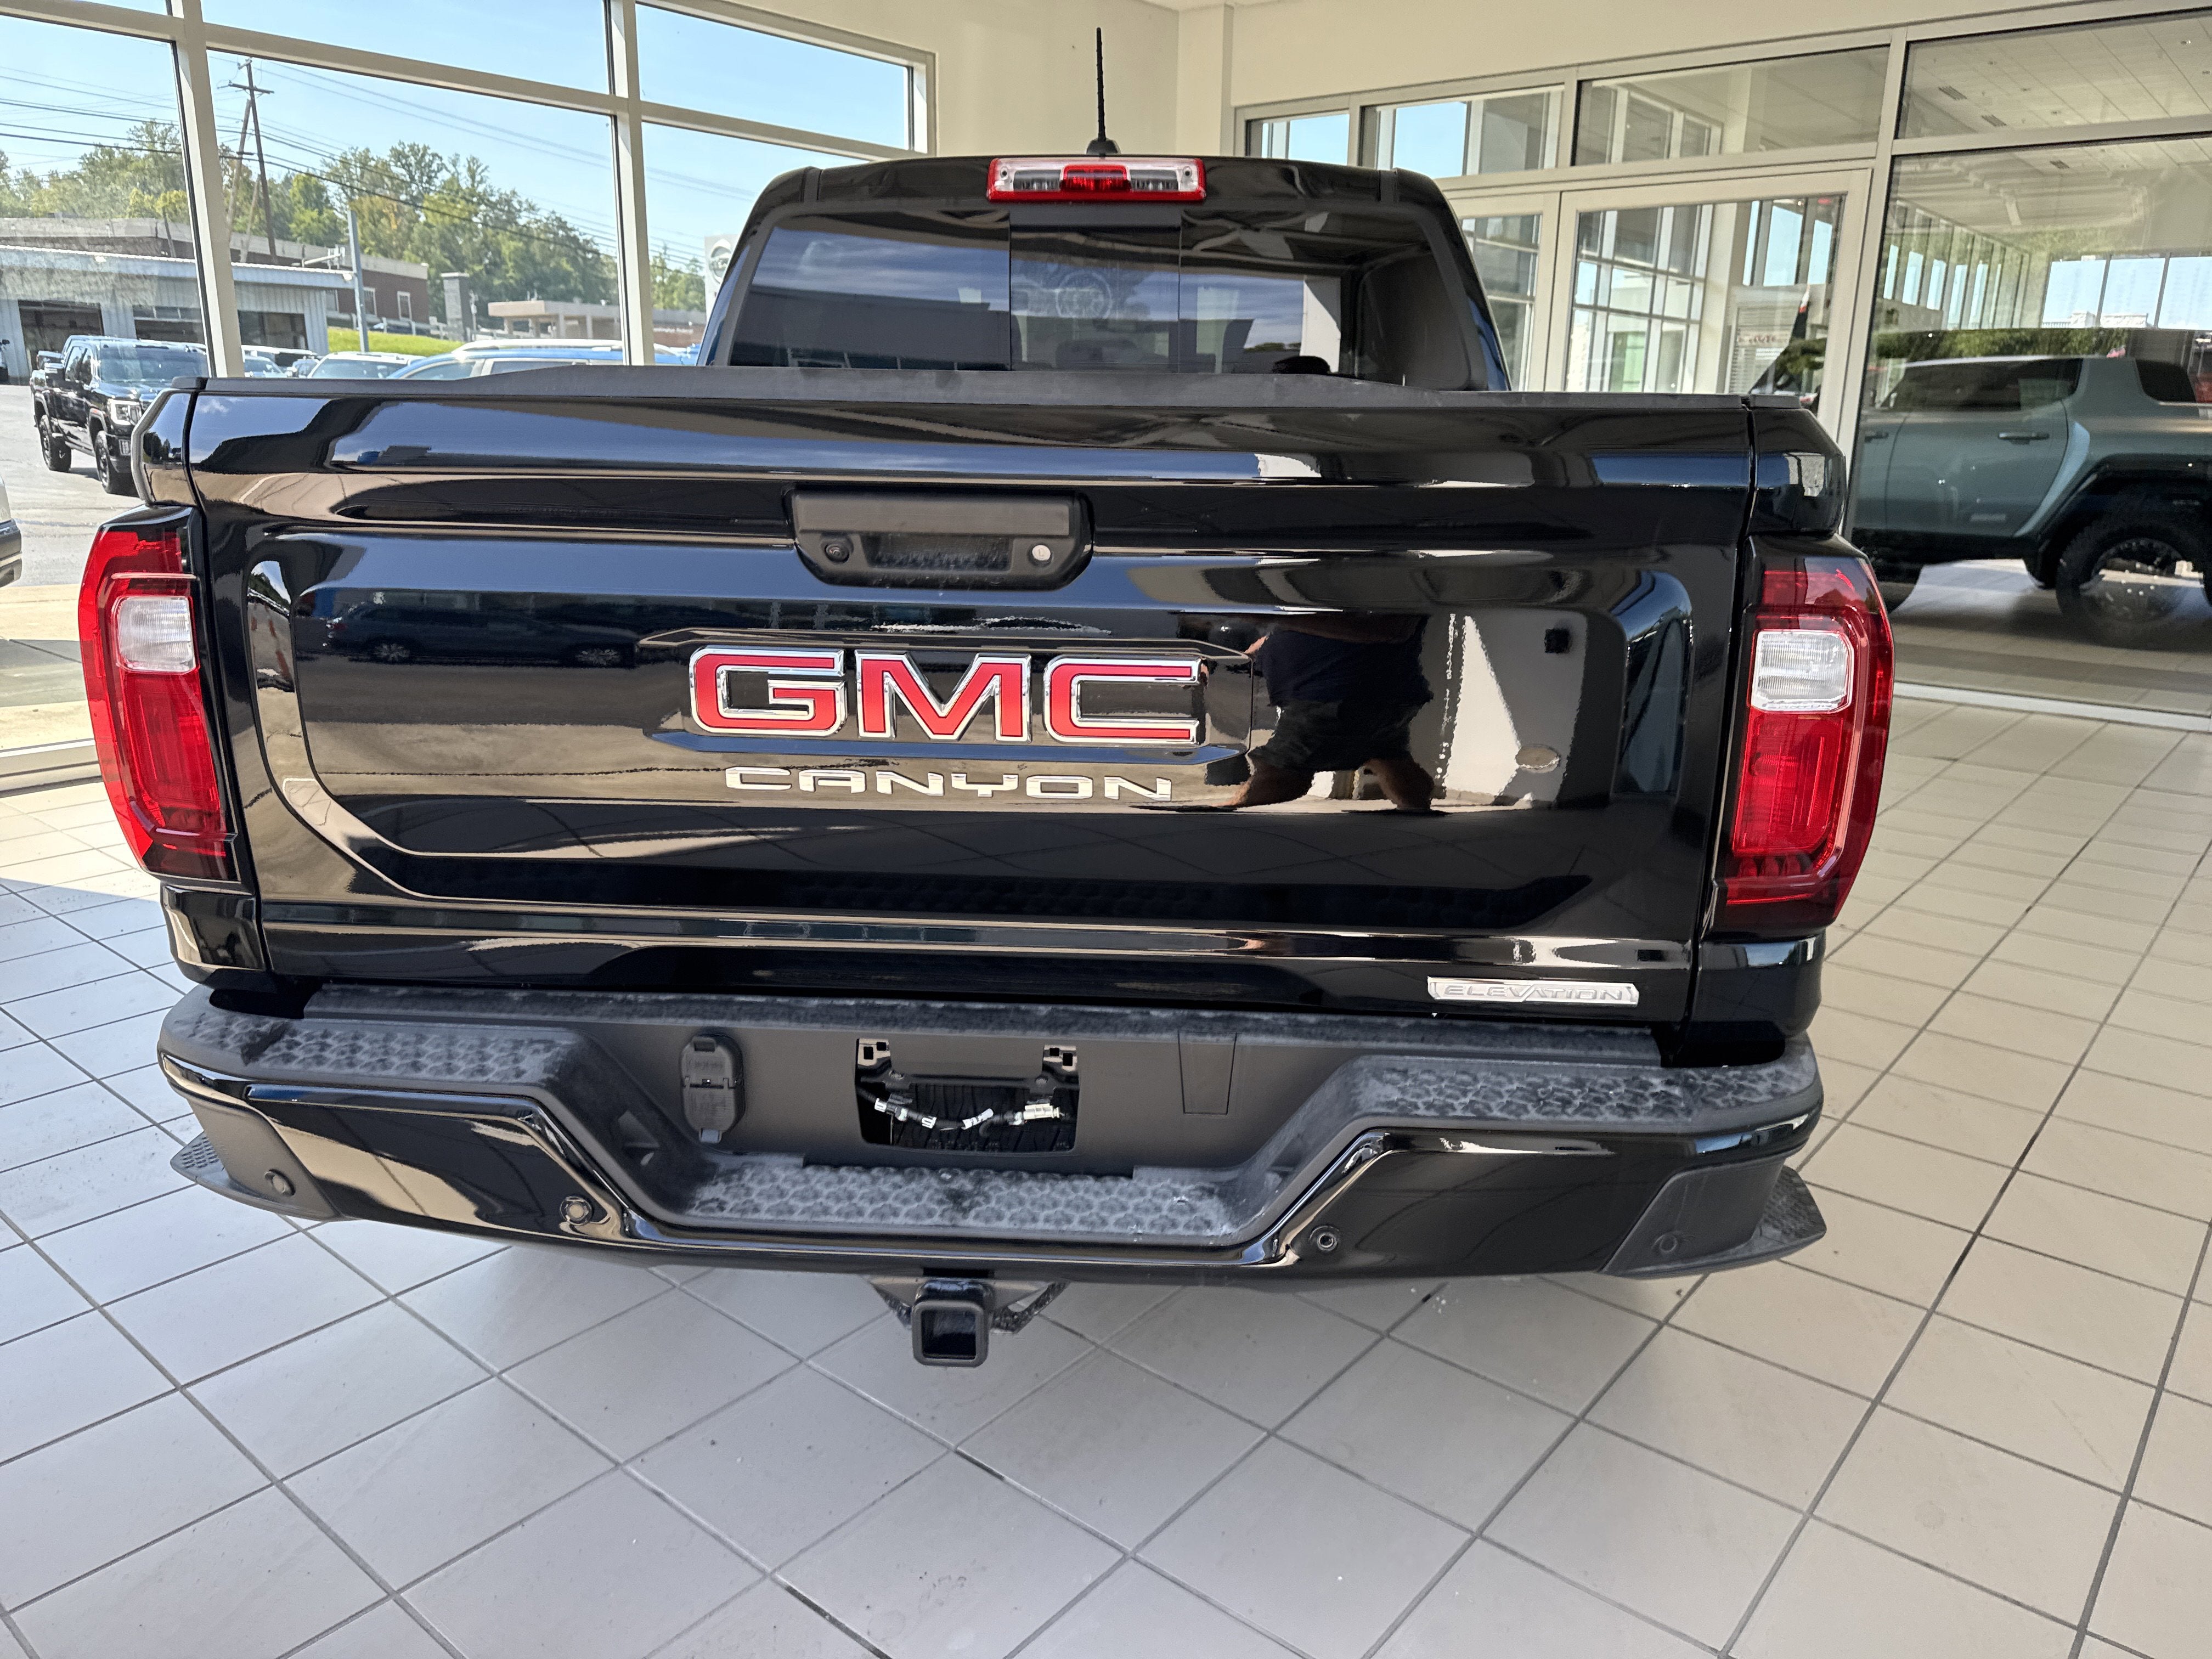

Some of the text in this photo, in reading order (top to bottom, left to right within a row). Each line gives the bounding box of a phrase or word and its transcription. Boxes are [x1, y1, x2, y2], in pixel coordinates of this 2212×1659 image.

[689, 646, 1203, 744] GMC
[725, 766, 1172, 802] CANYON
[1443, 984, 1625, 1002] ELEVATION
